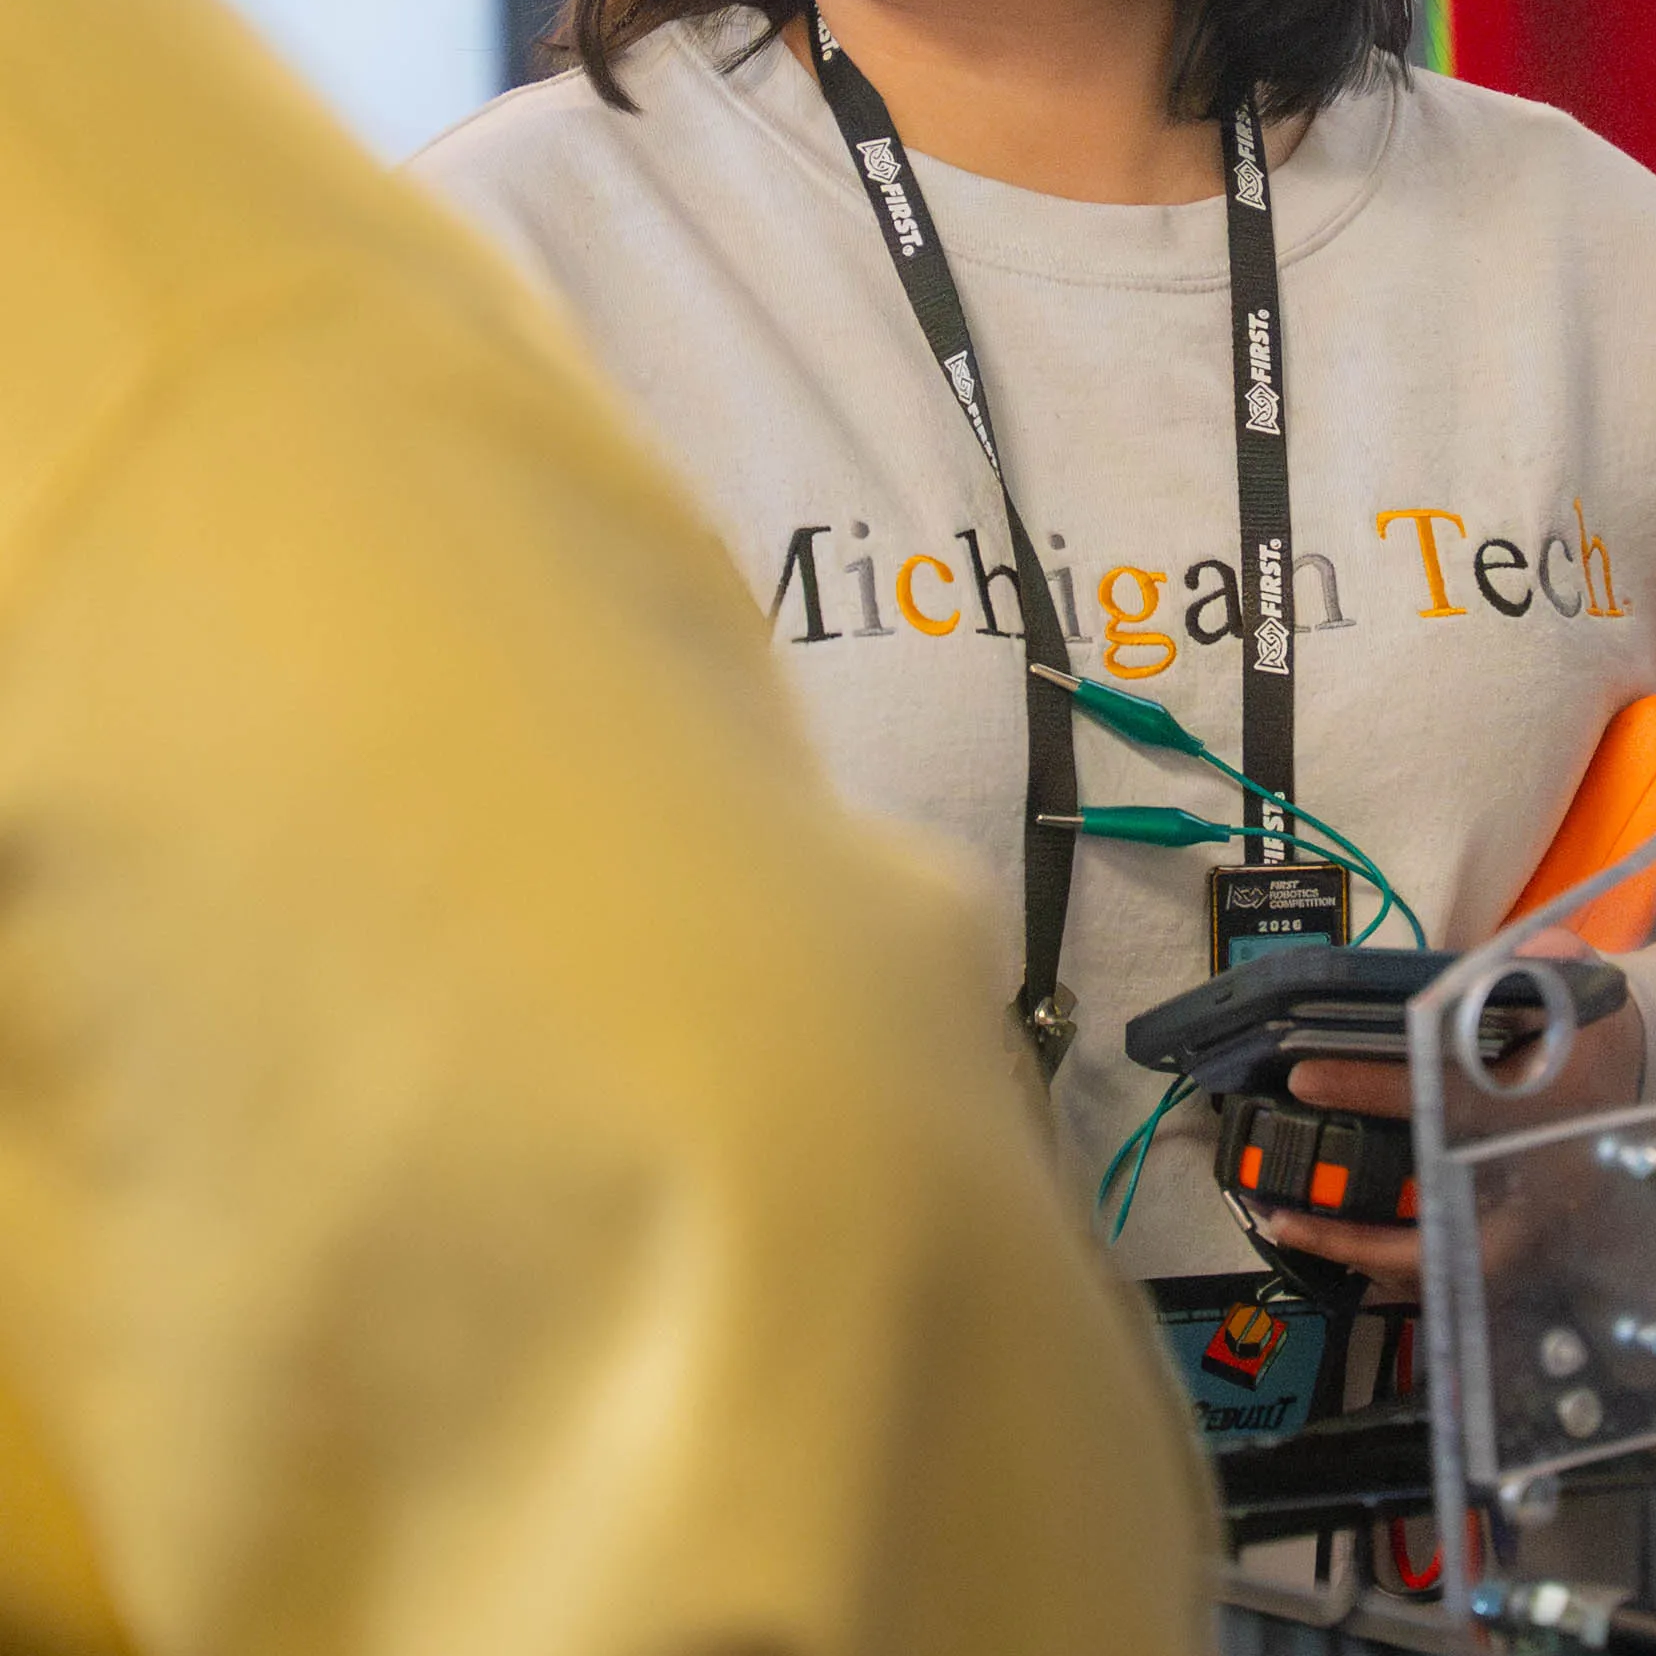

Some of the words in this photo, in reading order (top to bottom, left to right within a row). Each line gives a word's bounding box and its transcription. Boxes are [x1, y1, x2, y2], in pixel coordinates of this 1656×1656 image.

[1376, 496, 1625, 618] Tech
[1269, 880, 1300, 890] FIRST
[1269, 888, 1320, 900] ROBOTICS
[1269, 896, 1336, 910] COMPETITION
